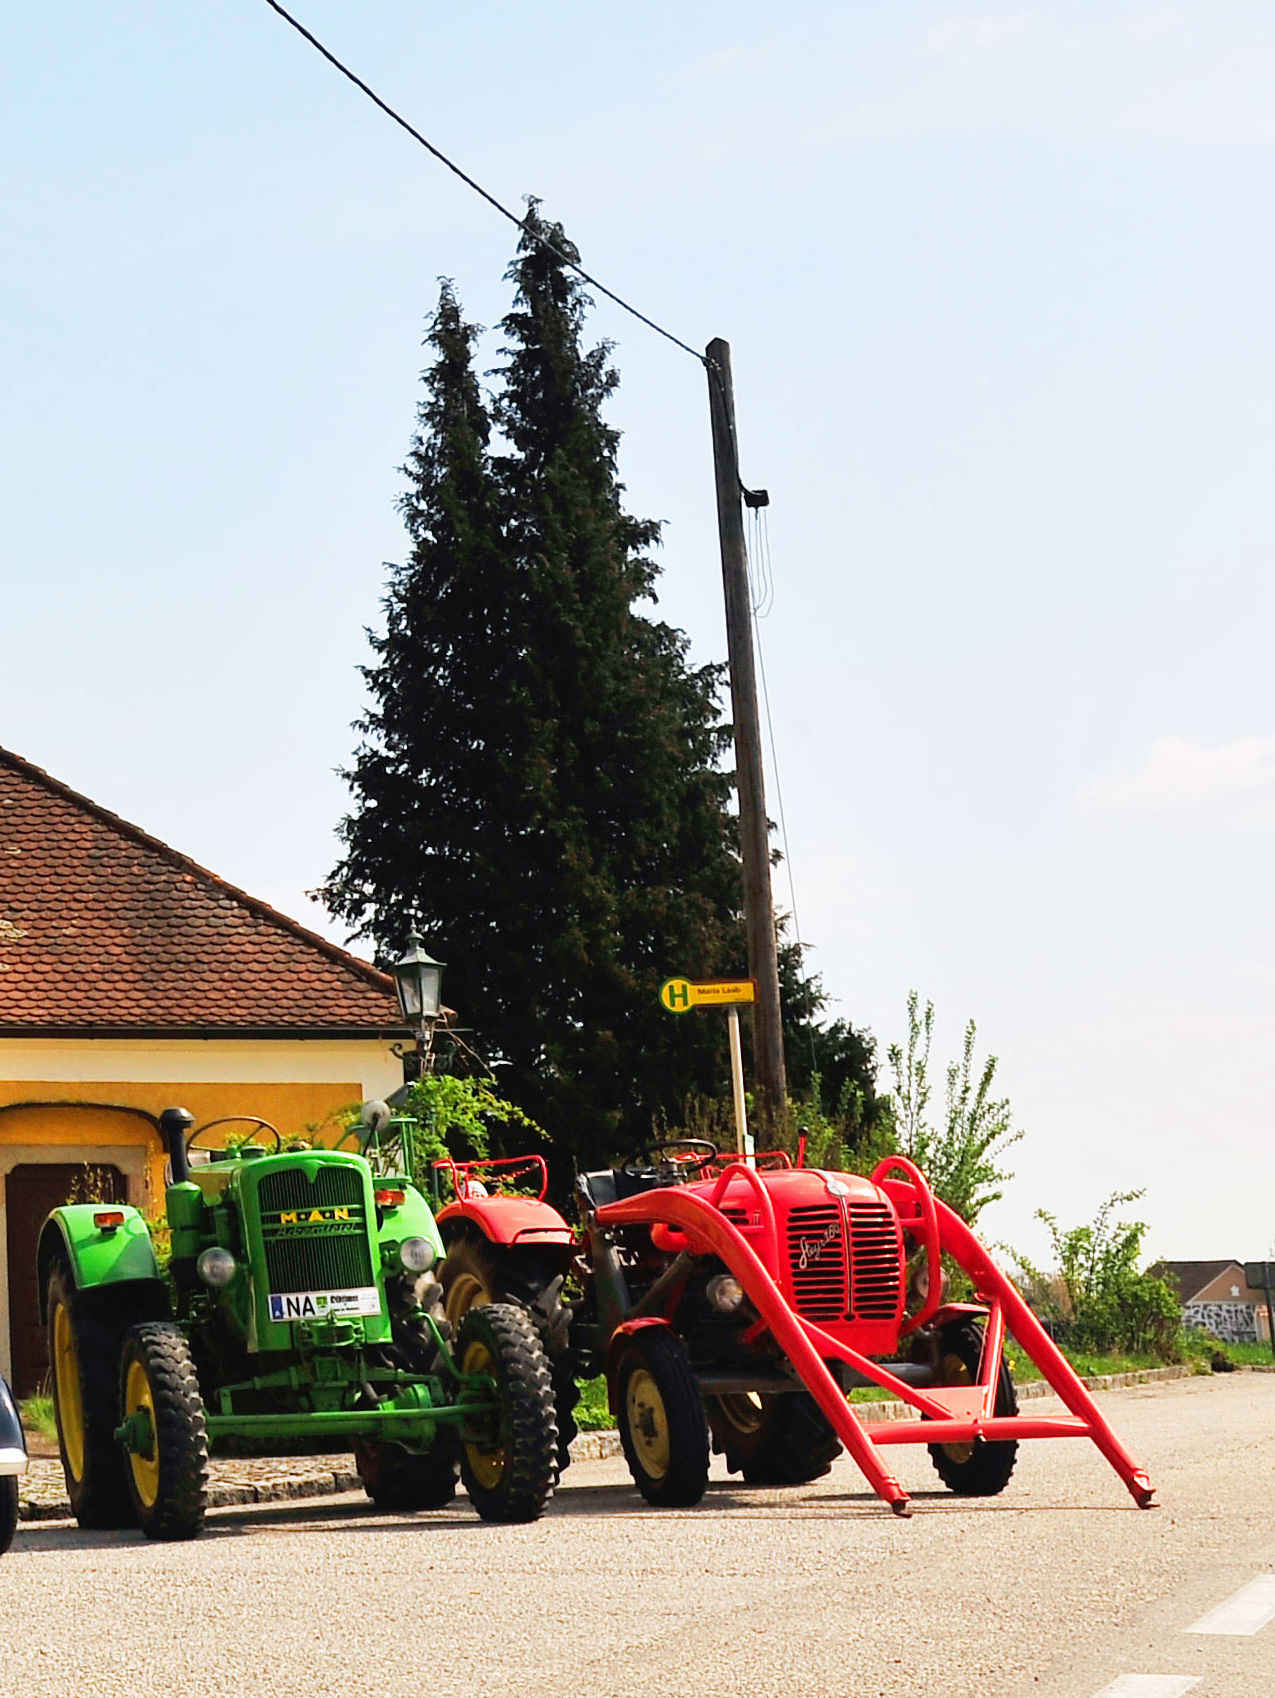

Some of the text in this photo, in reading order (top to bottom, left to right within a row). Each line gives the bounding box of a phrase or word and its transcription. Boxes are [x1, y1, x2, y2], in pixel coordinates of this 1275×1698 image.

[668, 984, 689, 1008] H
[697, 987, 720, 995] Maria
[286, 1295, 316, 1317] NA
